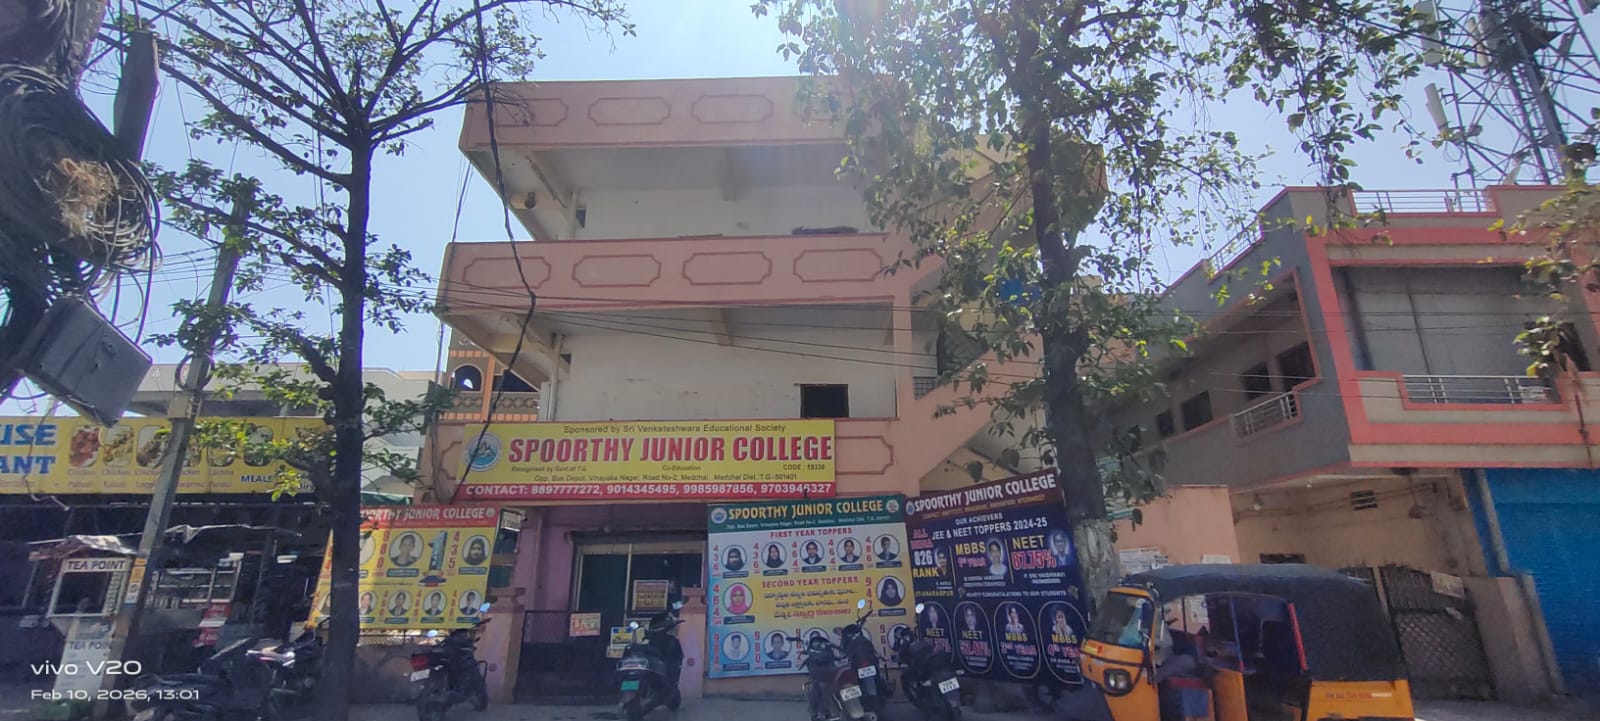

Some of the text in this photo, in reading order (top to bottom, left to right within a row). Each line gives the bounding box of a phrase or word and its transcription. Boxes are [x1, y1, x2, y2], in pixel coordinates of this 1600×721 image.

[564, 423, 786, 434] Sponsored by Sri Venkateshwara Educational Society
[509, 436, 832, 462] SPOORTHY JUNIOR COLLEGE
[466, 485, 528, 495] CONTACT:
[531, 485, 603, 496] 8897777272,
[607, 484, 680, 495] 9014345495,
[683, 484, 757, 495] 9985987856,
[914, 492, 962, 512] SPOORTHY
[964, 485, 1003, 505] JUNIOR
[1005, 473, 1057, 495] COLLEGE
[403, 508, 439, 521] JUNIOR
[443, 508, 485, 519] COLLEGE
[728, 505, 788, 520] SPOORTHY
[791, 502, 833, 519] JUNIOR
[836, 500, 883, 514] COLLEGE
[955, 513, 1003, 526] OUR ACHIEVERS
[770, 527, 853, 539] FIRST YEAR TOPPERS
[932, 516, 1048, 541] JEE & NEET TOPPERS 2024-25
[1012, 534, 1045, 549] NEET
[955, 541, 986, 556] MBBS
[68, 560, 126, 570] TEA POINT
[912, 567, 939, 578] RANK
[762, 576, 858, 589] SECOND YEAR TOPPERS
[926, 628, 944, 637] NEET
[962, 631, 983, 640] NEET
